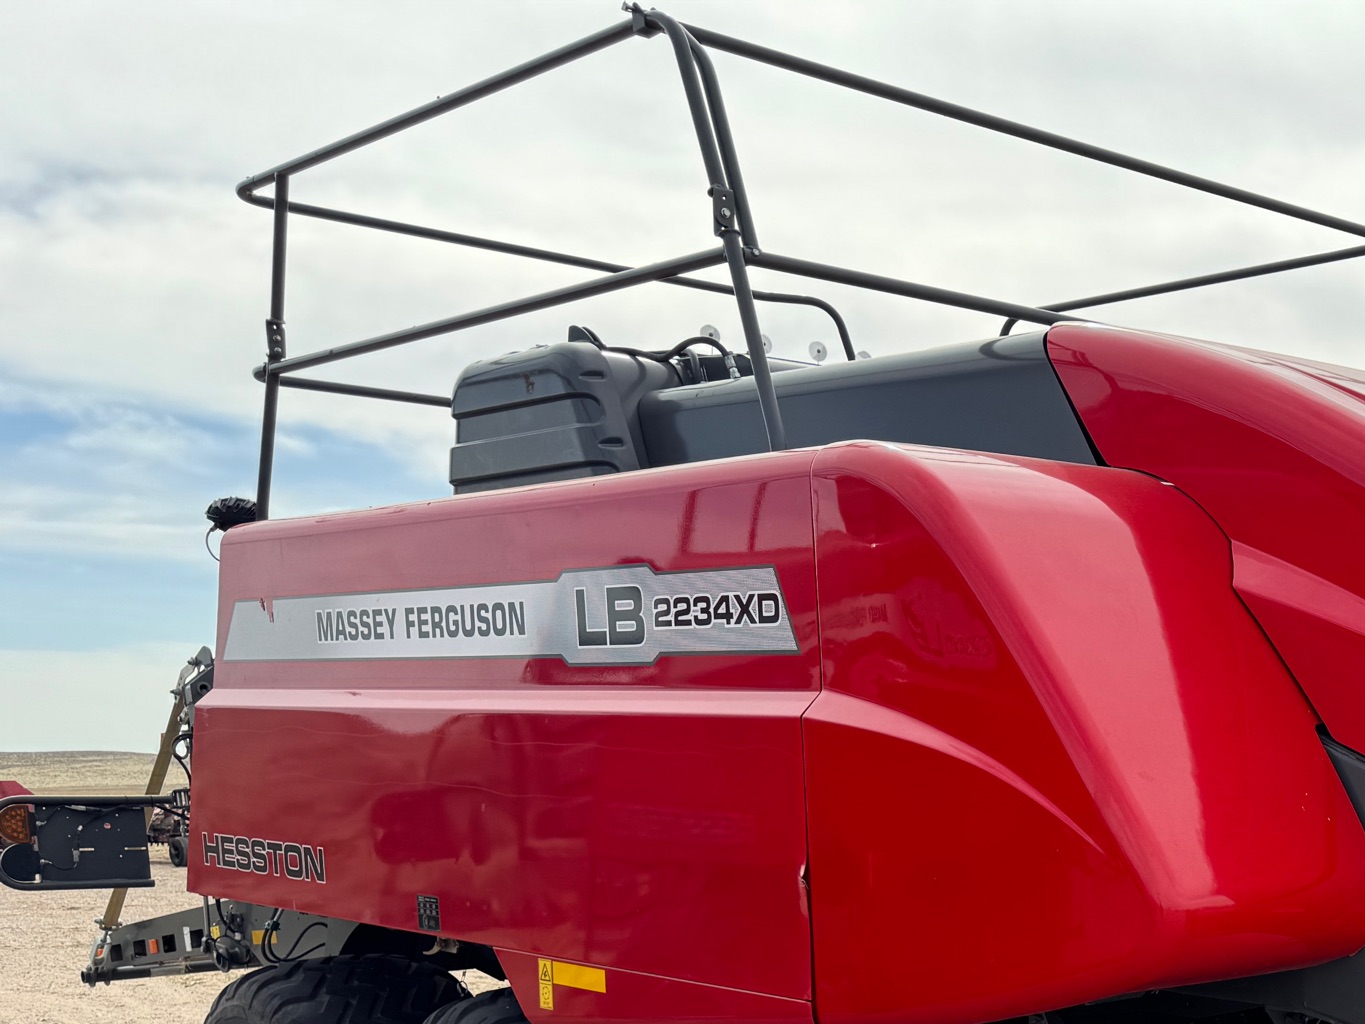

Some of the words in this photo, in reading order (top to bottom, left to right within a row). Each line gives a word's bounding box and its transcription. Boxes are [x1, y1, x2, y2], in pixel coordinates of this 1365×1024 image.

[315, 607, 398, 642] MASSEY
[403, 600, 527, 640] FERGUSON
[574, 585, 646, 648] LB
[652, 592, 780, 629] 2234XD
[202, 831, 327, 884] HESSTON
